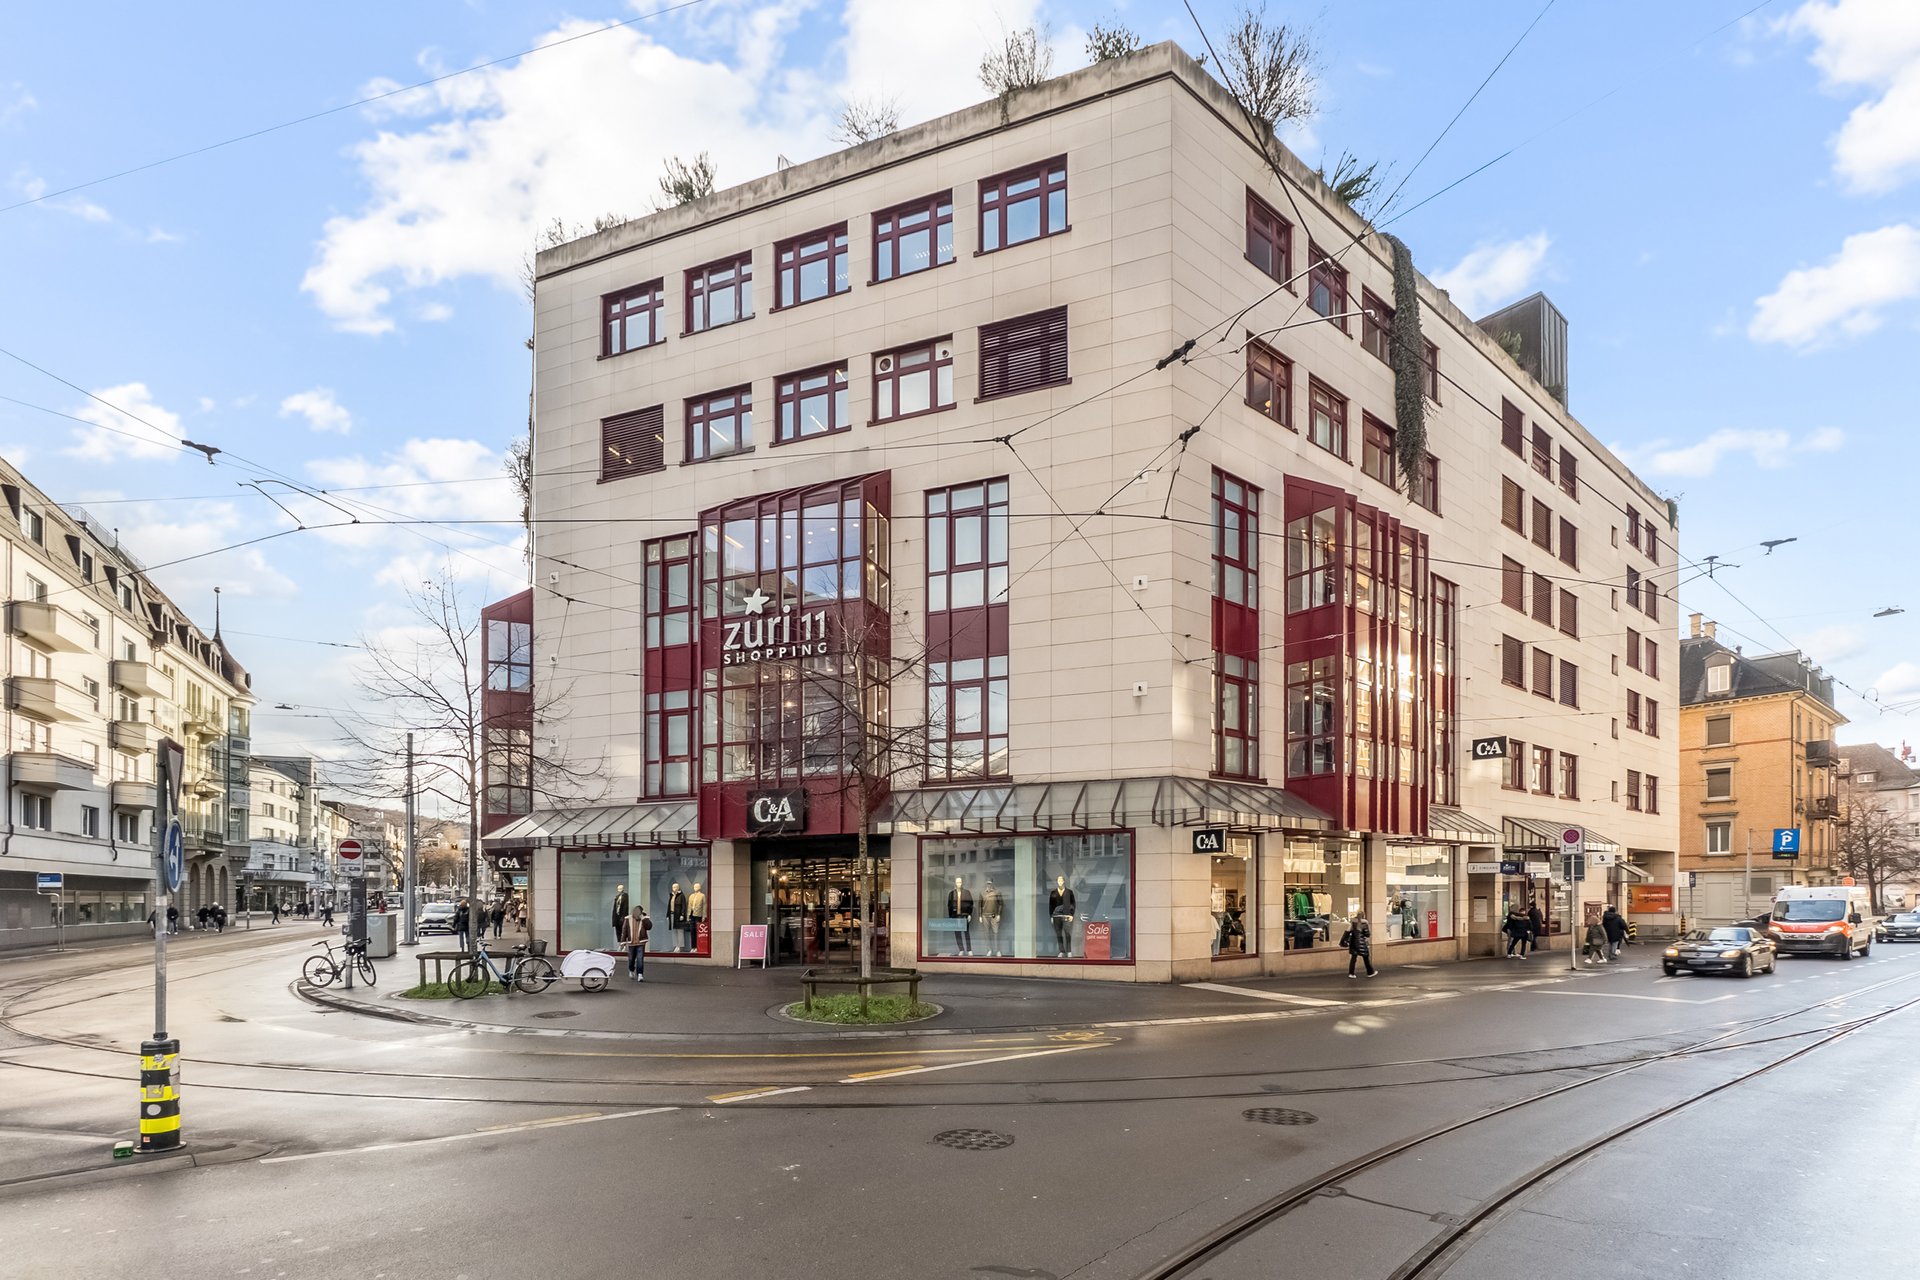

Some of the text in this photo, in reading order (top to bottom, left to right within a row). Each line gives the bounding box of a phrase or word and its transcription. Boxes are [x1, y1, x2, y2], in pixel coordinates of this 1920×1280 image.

[801, 611, 826, 641] 11
[723, 642, 827, 665] SHOPPING
[1476, 741, 1503, 756] C&A
[754, 797, 796, 823] C&A
[1196, 834, 1219, 849] C&A
[1782, 835, 1793, 846] P
[498, 857, 520, 869] C&A
[1087, 924, 1110, 935] Sale
